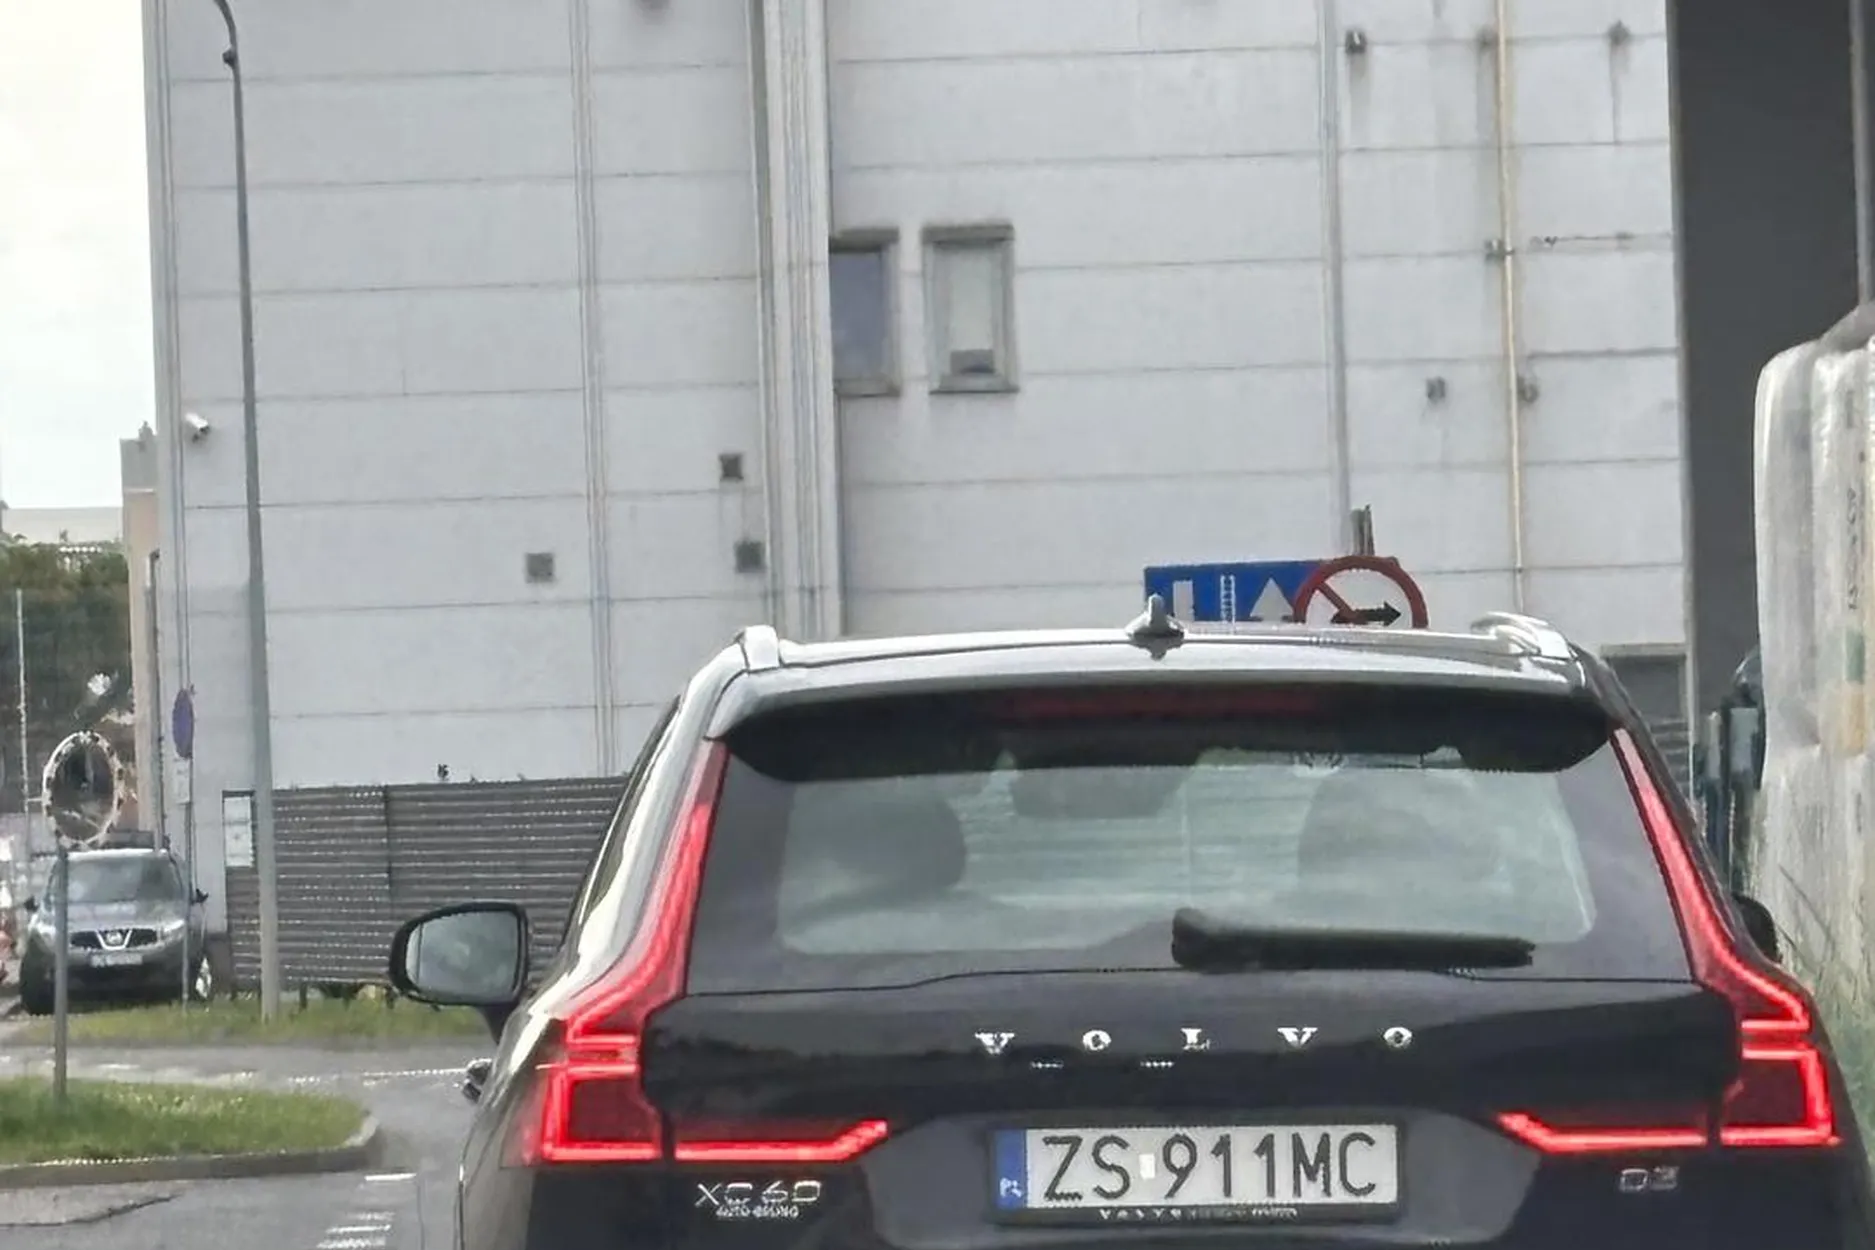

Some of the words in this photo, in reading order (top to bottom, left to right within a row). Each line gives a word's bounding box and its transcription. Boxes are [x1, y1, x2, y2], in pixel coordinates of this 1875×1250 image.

[975, 1027, 1413, 1054] VOLVO
[1042, 1134, 1132, 1201] ZS
[1161, 1131, 1377, 1199] 911MC
[695, 1180, 822, 1206] XC60
